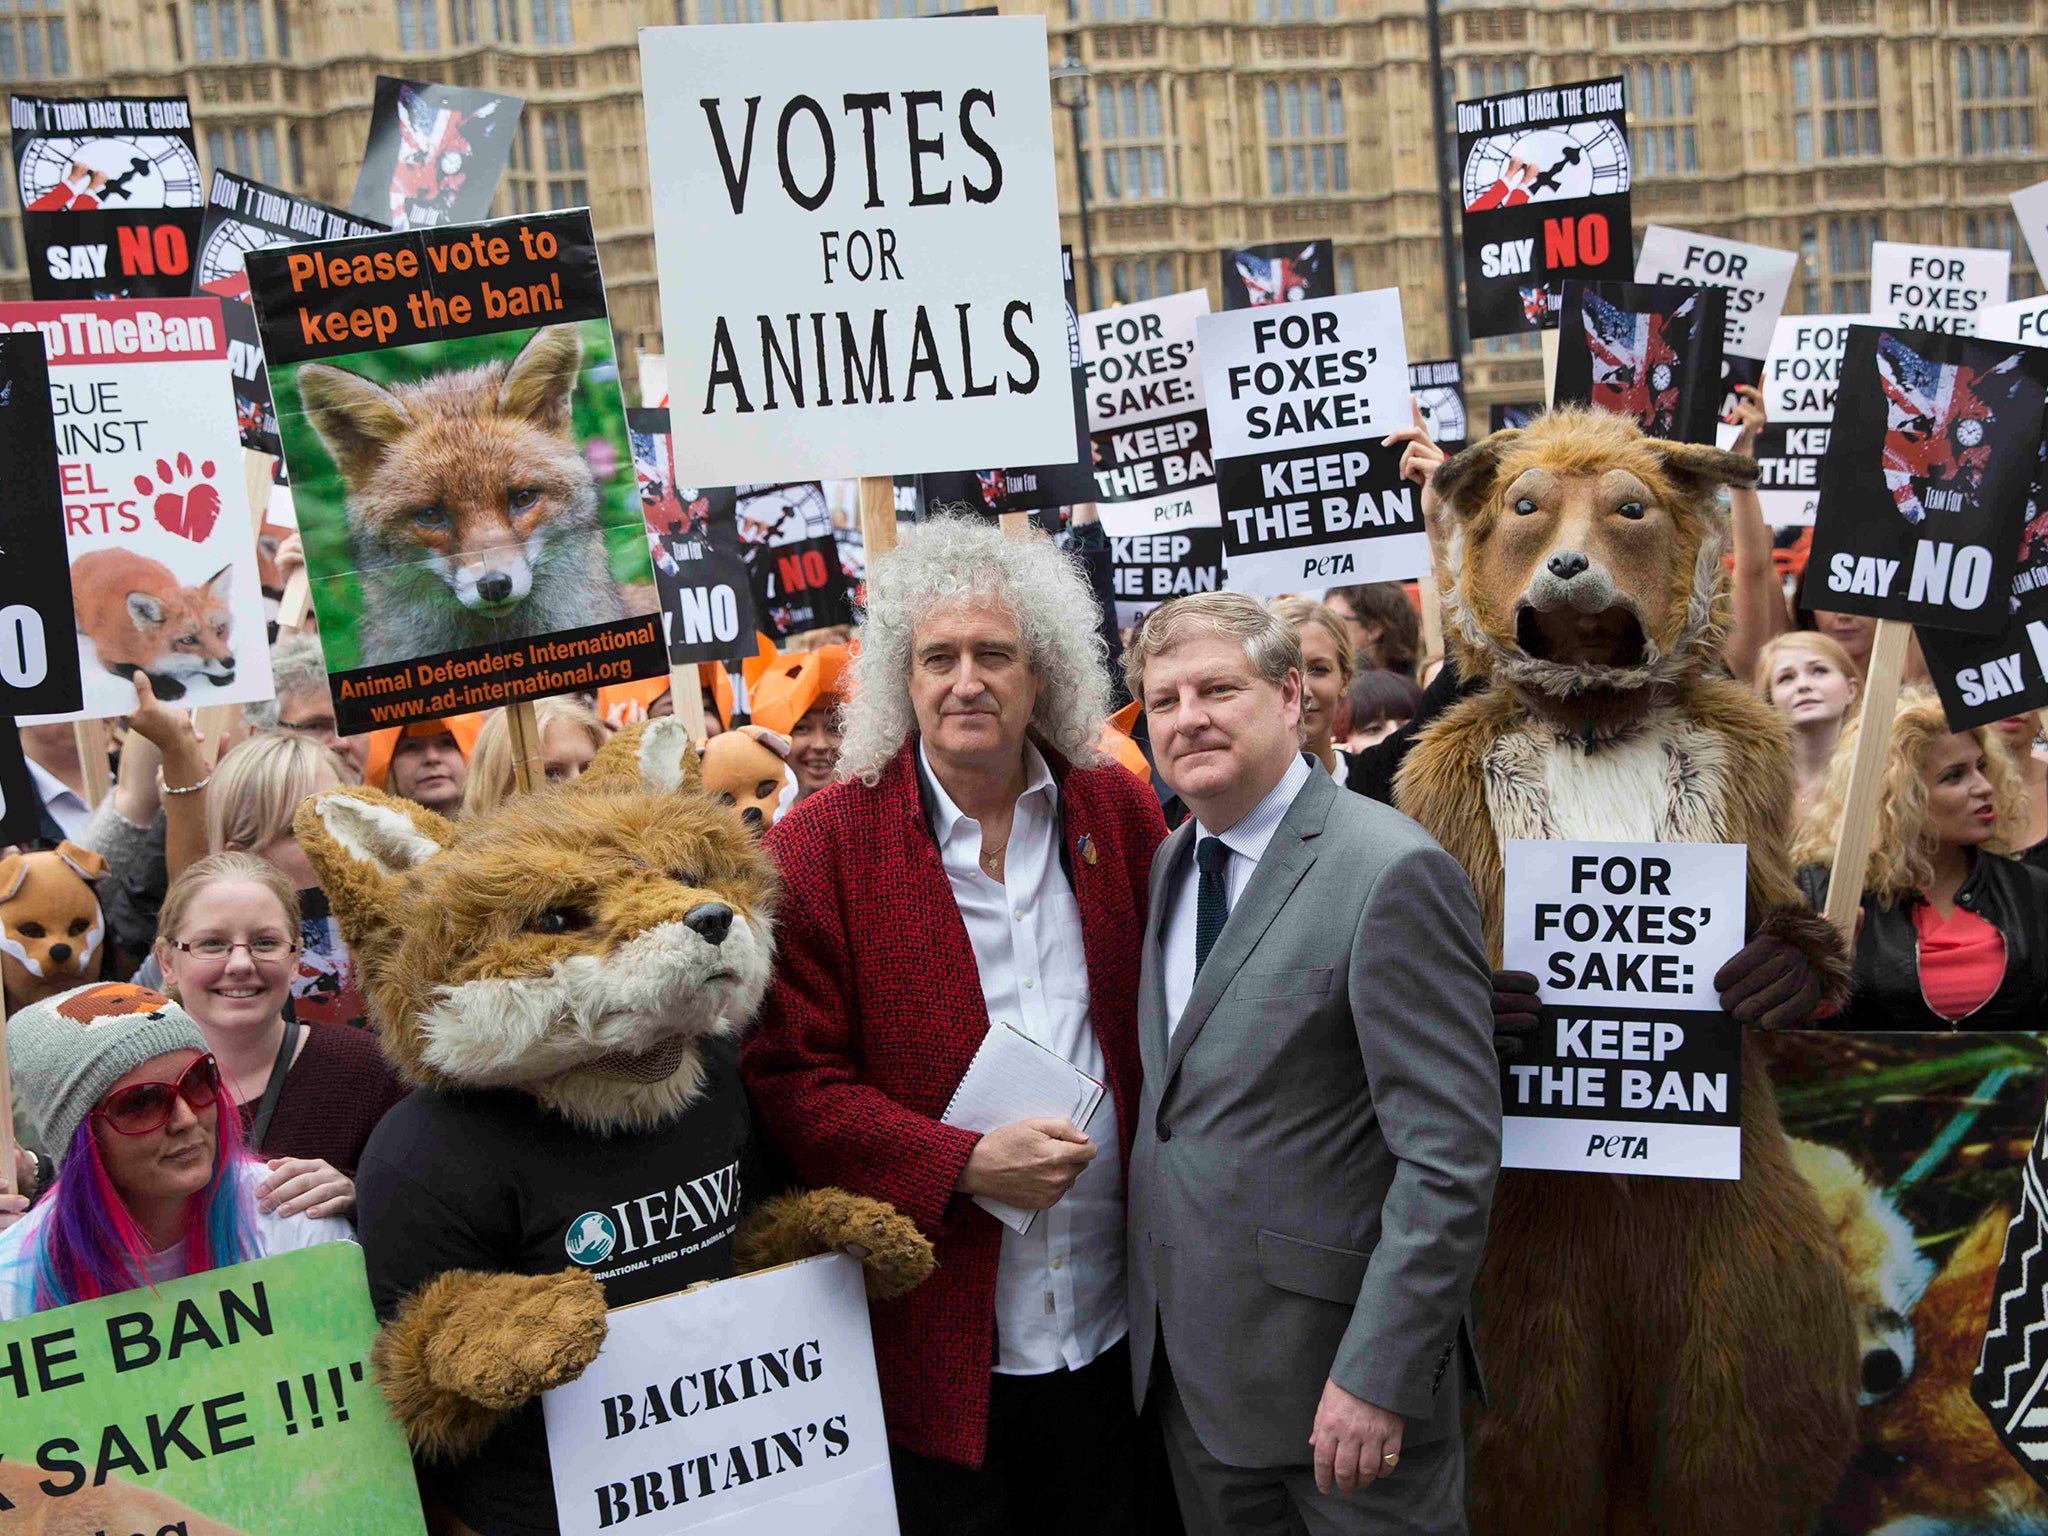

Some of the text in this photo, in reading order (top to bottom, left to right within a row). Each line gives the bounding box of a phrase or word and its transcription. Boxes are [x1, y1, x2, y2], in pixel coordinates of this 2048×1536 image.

[53, 103, 88, 131] TURN
[88, 101, 125, 129] BACK
[124, 101, 149, 129] THE
[149, 101, 191, 129] CLOCK
[1497, 95, 1526, 127] TURN
[1527, 91, 1560, 121] BACK
[1560, 88, 1584, 117] THE
[1585, 82, 1623, 114] CLOCK
[699, 87, 1003, 215] VOTES
[255, 191, 290, 227] TURN
[289, 201, 326, 238] BACK
[325, 213, 348, 240] THE
[46, 224, 190, 280] SAY NO
[287, 226, 558, 293] Please vote to
[820, 228, 904, 284] FOR
[1480, 213, 1610, 278] SAY NO
[1684, 246, 1747, 280] FOR
[1911, 257, 1965, 281] FOR
[300, 272, 563, 345] keep the ban!
[1889, 284, 1987, 311] FOXES'
[1096, 313, 1164, 350] FOR
[1253, 311, 1340, 354] FOR
[1899, 313, 1976, 338] SAKE:
[2018, 309, 2048, 340] FO
[702, 300, 1040, 415] ANIMALS
[1081, 340, 1194, 389] FOXES'
[1228, 347, 1377, 400] FOXES'
[50, 382, 122, 416] GUE
[1096, 377, 1195, 419] SAKE:
[1246, 393, 1372, 440] SAKE:
[1782, 389, 1838, 411] SAK
[1111, 420, 1199, 463] KEEP
[1785, 428, 1831, 455] KE
[1093, 446, 1216, 498] THE BA
[1260, 451, 1370, 499] KEEP
[1758, 458, 1817, 485] THE
[1227, 487, 1414, 545] THE BAN
[1924, 486, 1964, 513] TEAM FOX
[778, 551, 828, 594] NO
[1110, 536, 1192, 564] KEEP
[1152, 566, 1217, 595] BAN
[1828, 539, 1993, 611] SAY NO
[679, 583, 739, 645] NO
[0, 604, 47, 688] O
[339, 669, 412, 701] Animal
[417, 652, 525, 688] Defenders
[529, 623, 655, 666] International
[370, 657, 632, 724] www.ad-international.org
[1956, 653, 2025, 707] SAY
[1571, 856, 1672, 896] FOR
[1534, 903, 1711, 945] FOXES'
[1546, 951, 1694, 994] SAKE:
[1556, 1018, 1685, 1061] KEEP
[1509, 1065, 1728, 1113] THE BAN
[611, 1162, 736, 1255] IFAW
[594, 1259, 650, 1281] RNATIONAL
[652, 1250, 678, 1265] FUND
[681, 1243, 700, 1257] FOR
[700, 1230, 726, 1249] ANIMAL
[0, 1281, 274, 1399] HE BAN
[600, 1339, 823, 1440] BACKING
[36, 1391, 255, 1498] SAKE
[594, 1414, 851, 1529] BRITAIN'S
